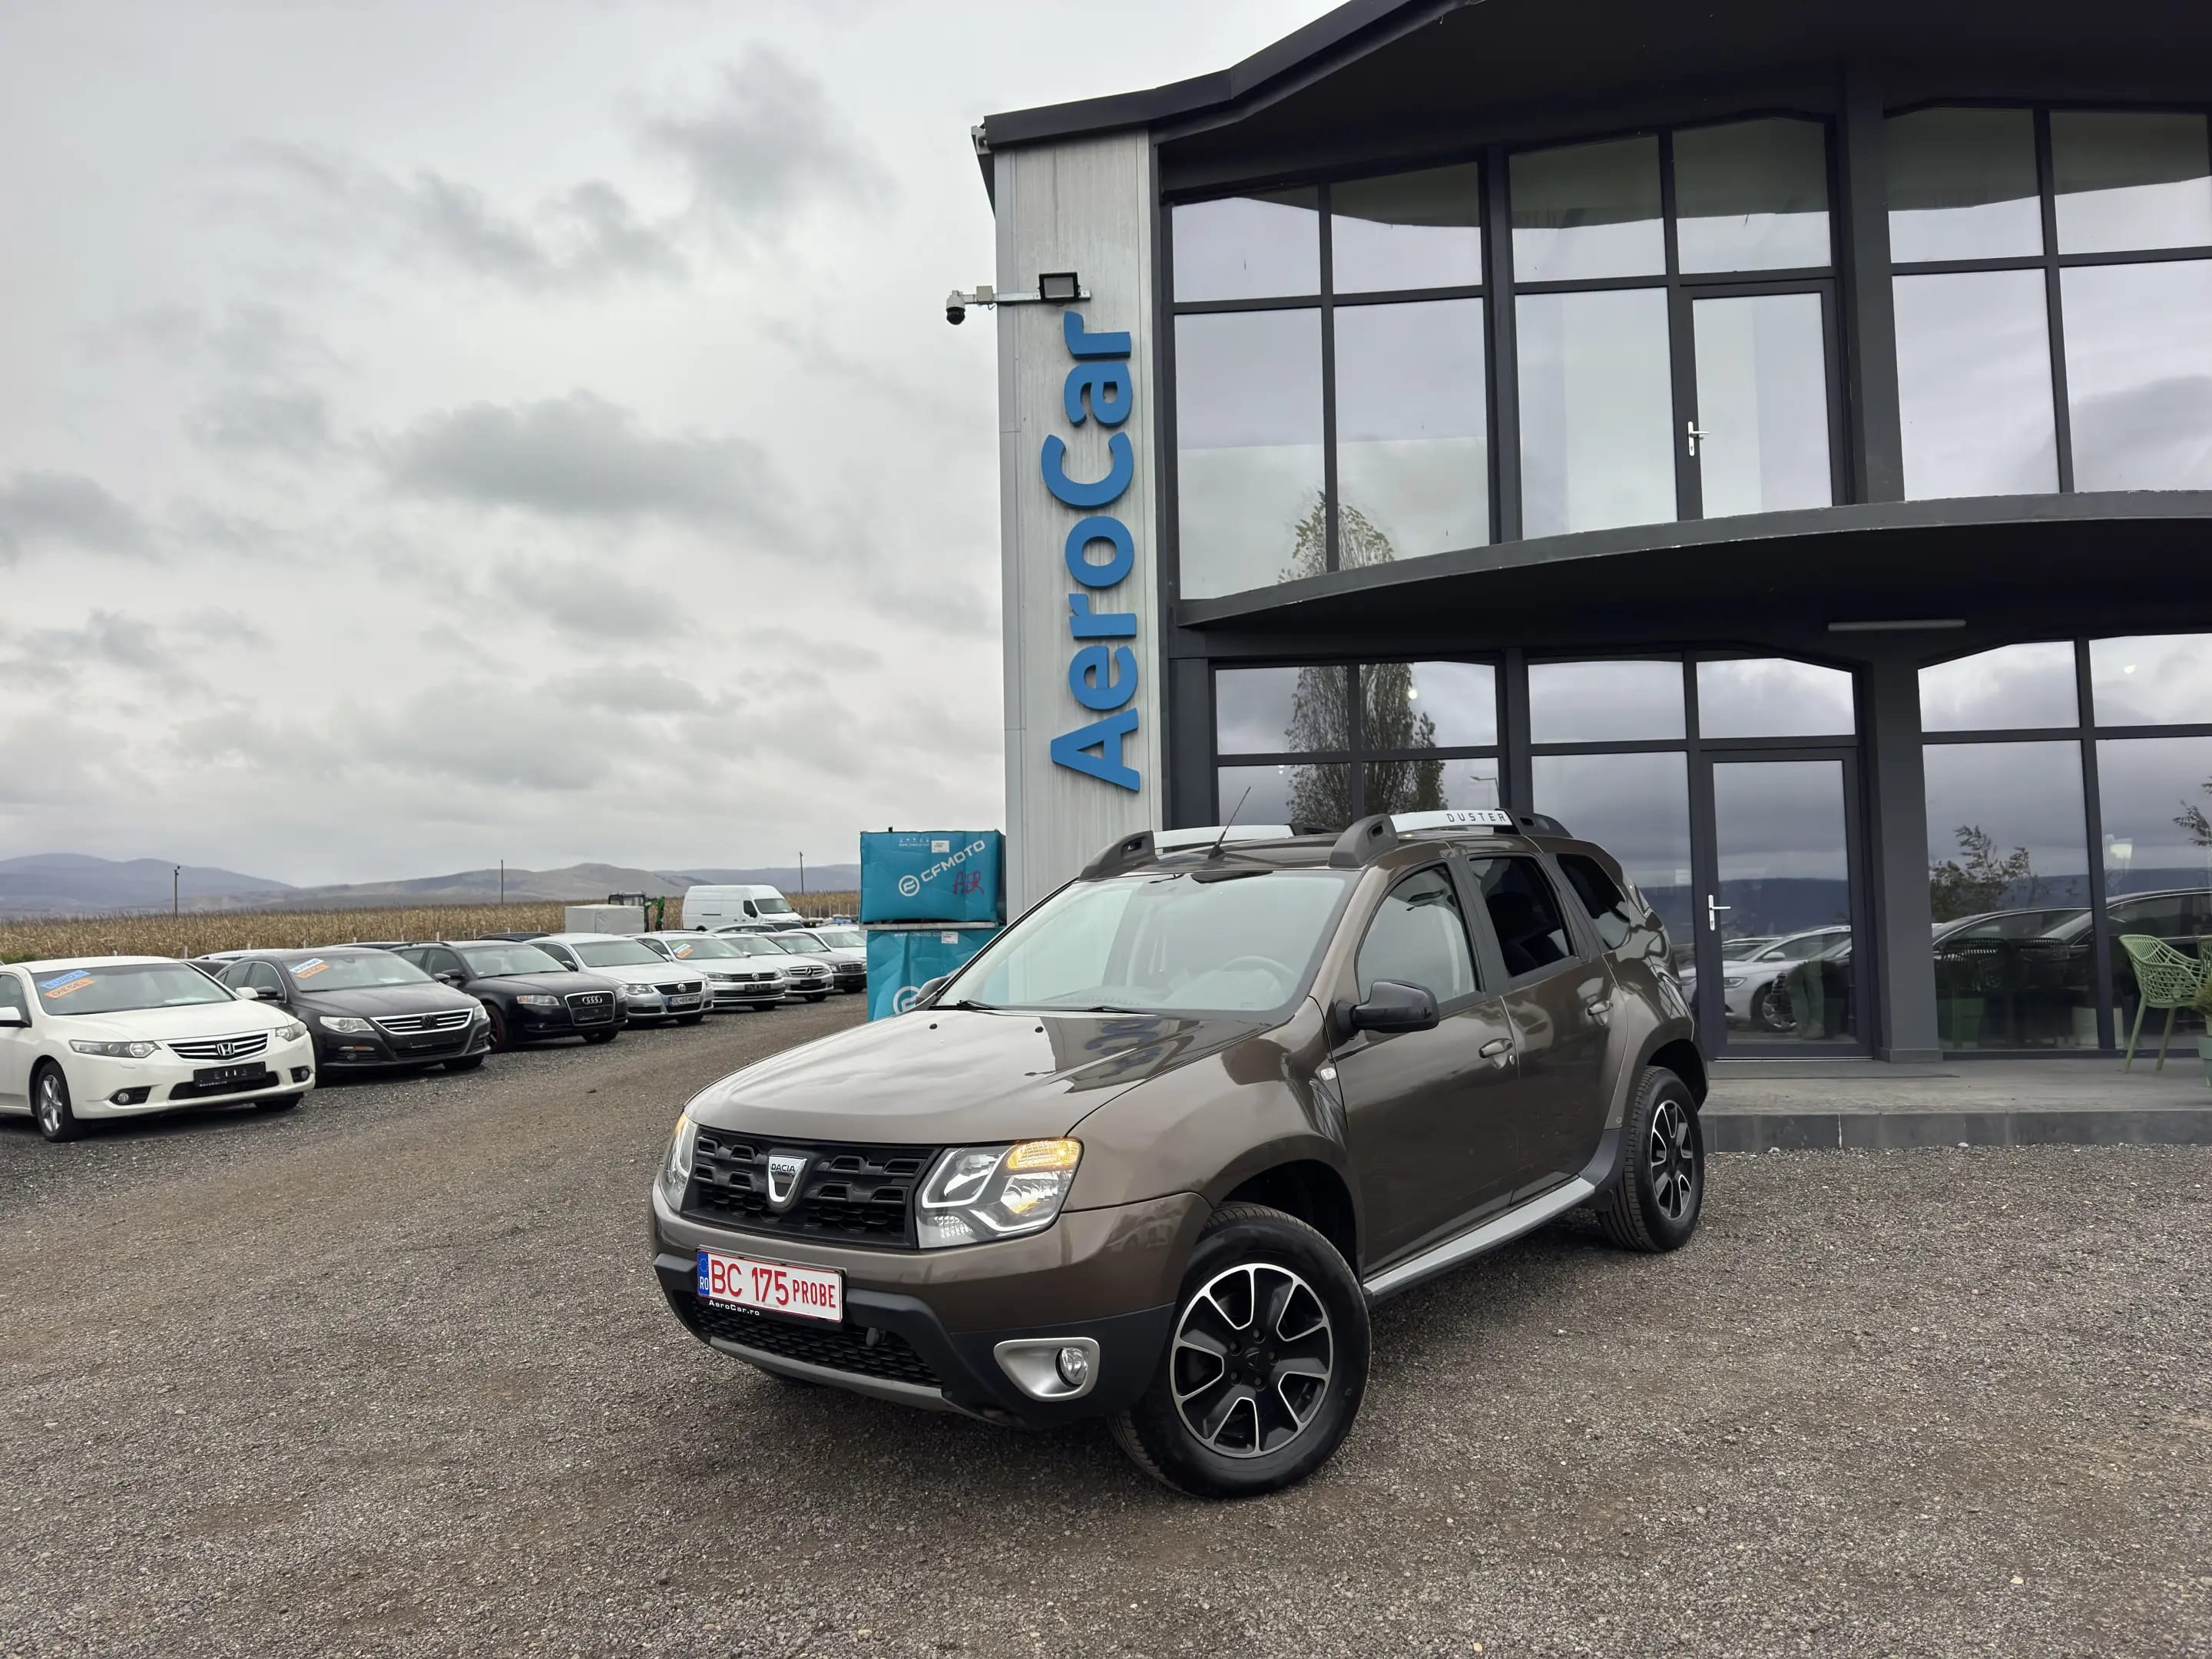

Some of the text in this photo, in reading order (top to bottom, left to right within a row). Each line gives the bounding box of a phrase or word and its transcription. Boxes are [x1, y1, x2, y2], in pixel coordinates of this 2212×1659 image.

[1041, 310, 1141, 793] AeroCar
[1445, 812, 1507, 823] DUSTER
[920, 839, 986, 882] CFMOTO
[770, 1163, 796, 1173] DACIA
[699, 1259, 836, 1309] RO BC 175 PROBE
[708, 1300, 760, 1316] AeroCar.ro
